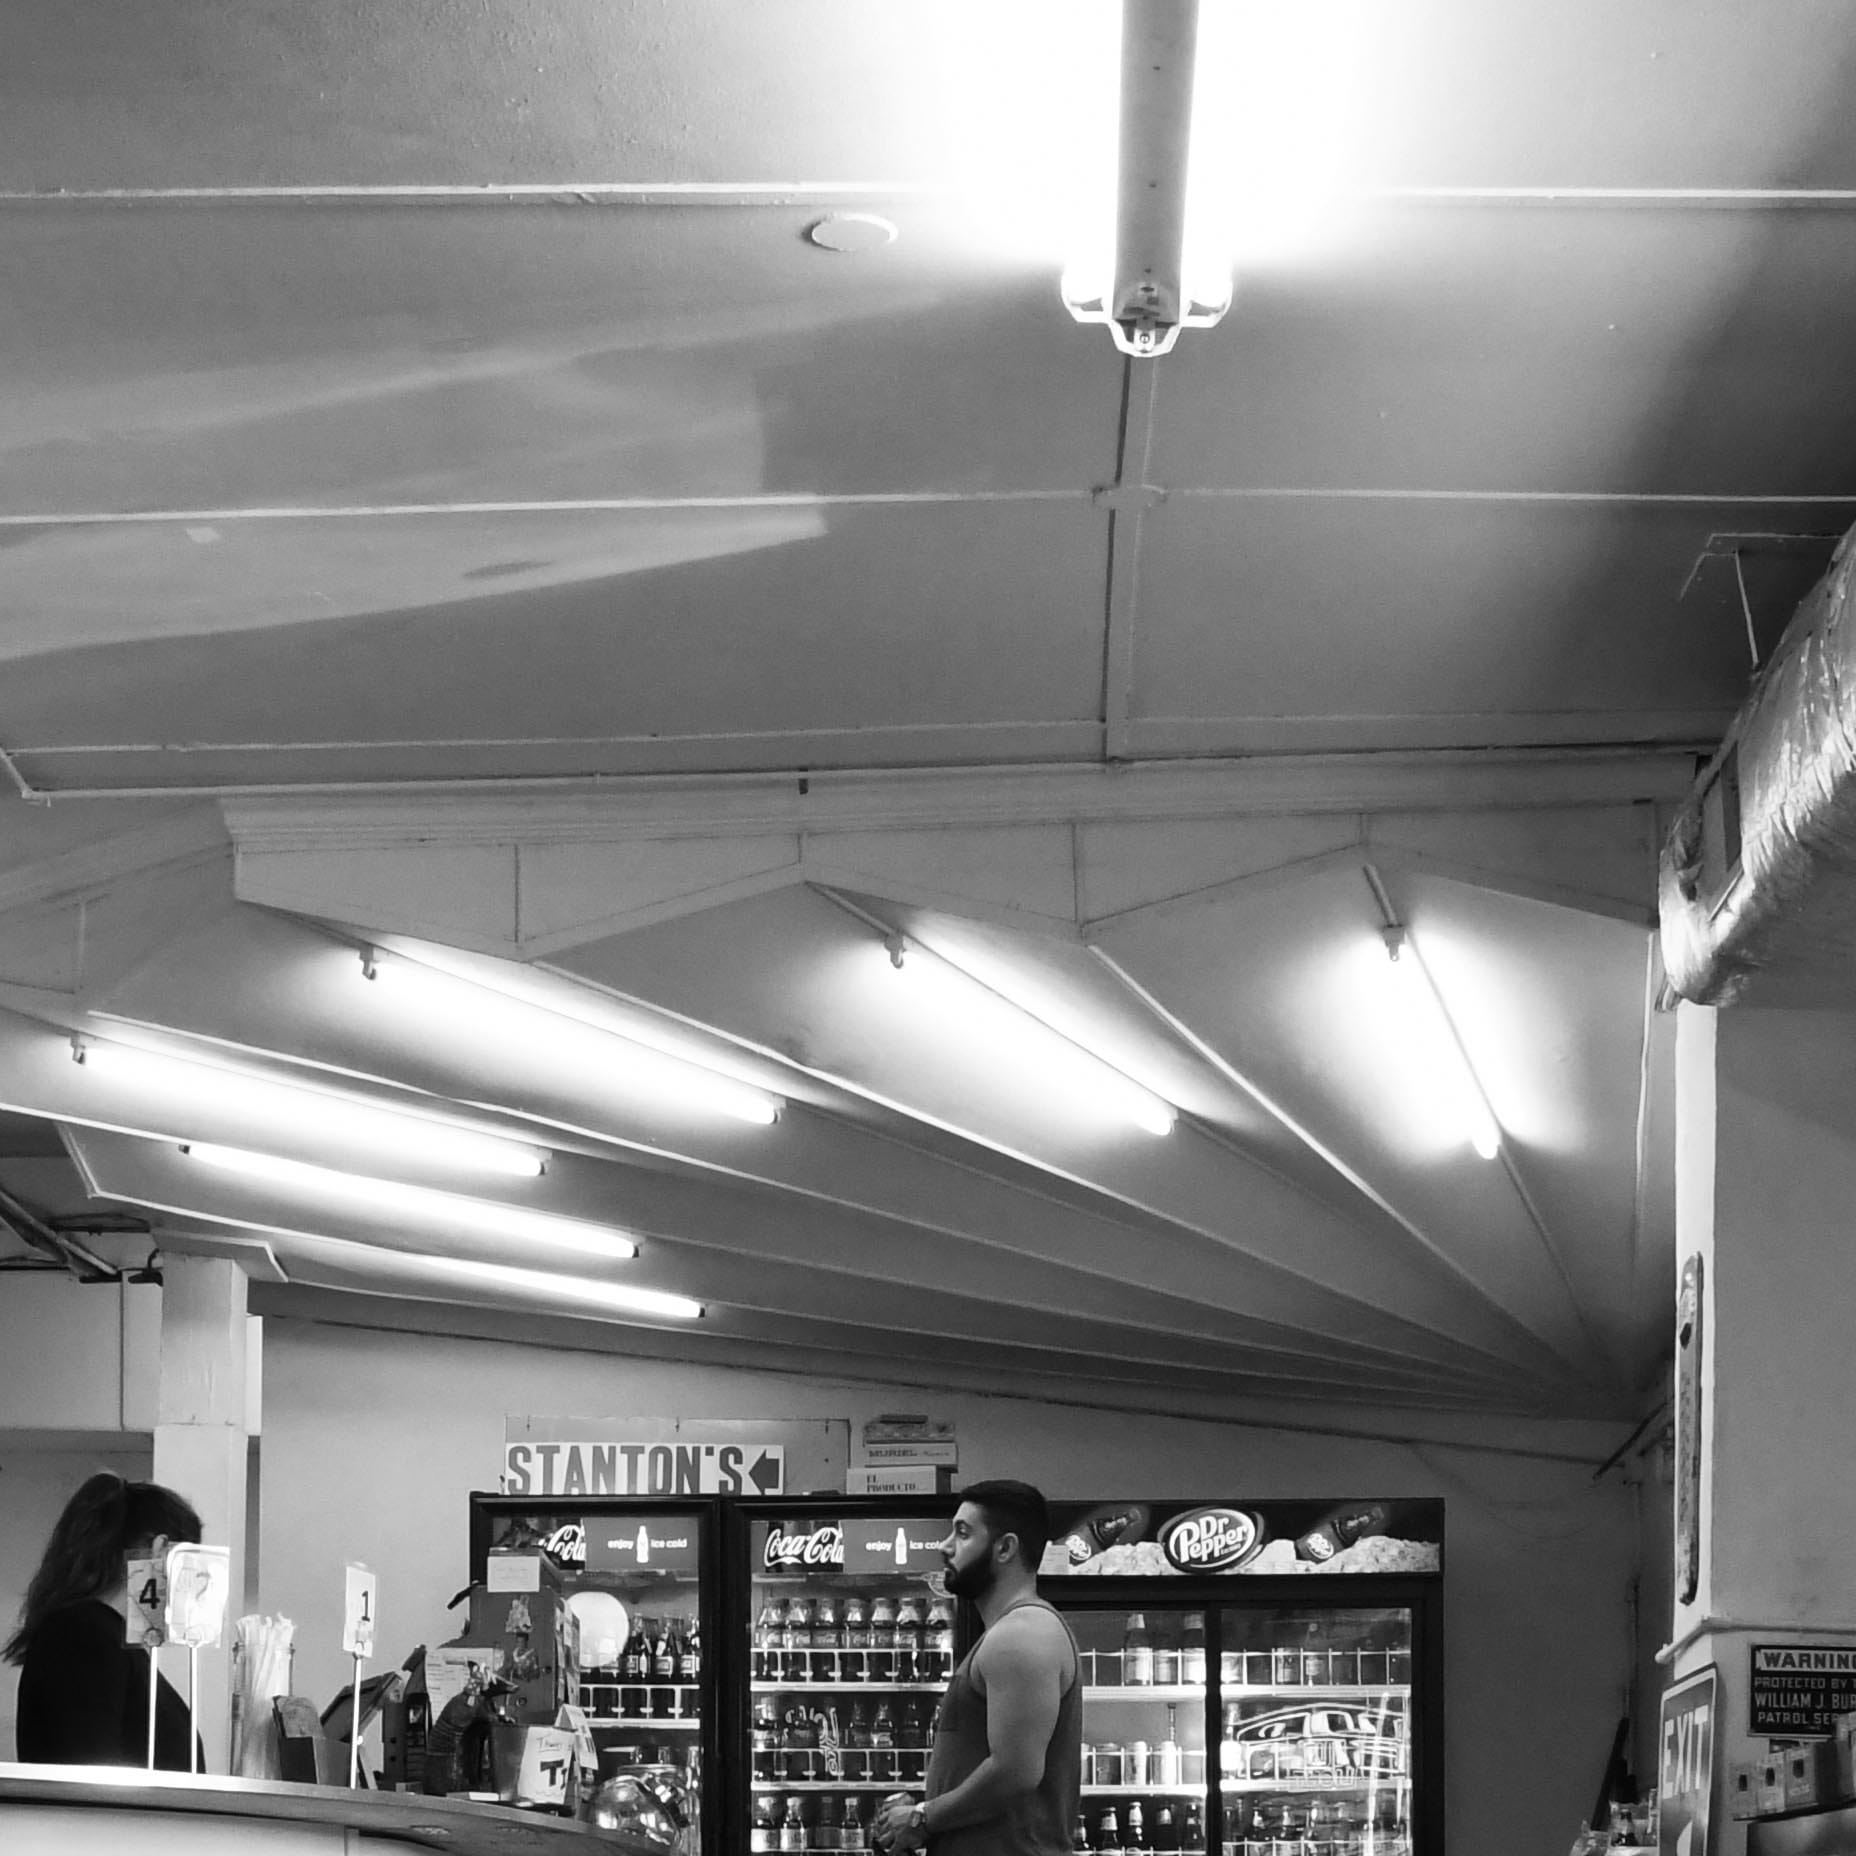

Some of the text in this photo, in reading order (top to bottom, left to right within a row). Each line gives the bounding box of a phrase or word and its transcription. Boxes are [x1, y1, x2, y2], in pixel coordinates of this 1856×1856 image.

[507, 1445, 744, 1496] STANTON'S
[1177, 1523, 1248, 1564] Pepper
[1198, 1516, 1230, 1540] Dr
[139, 1578, 161, 1609] 4
[360, 1591, 371, 1622] 1
[1755, 1677, 1826, 1690] PROTECTED
[1831, 1678, 1848, 1690] BY
[1754, 1693, 1811, 1709] WILLIAM
[1758, 1711, 1809, 1724] PATROL
[1662, 1704, 1709, 1800] EXIT
